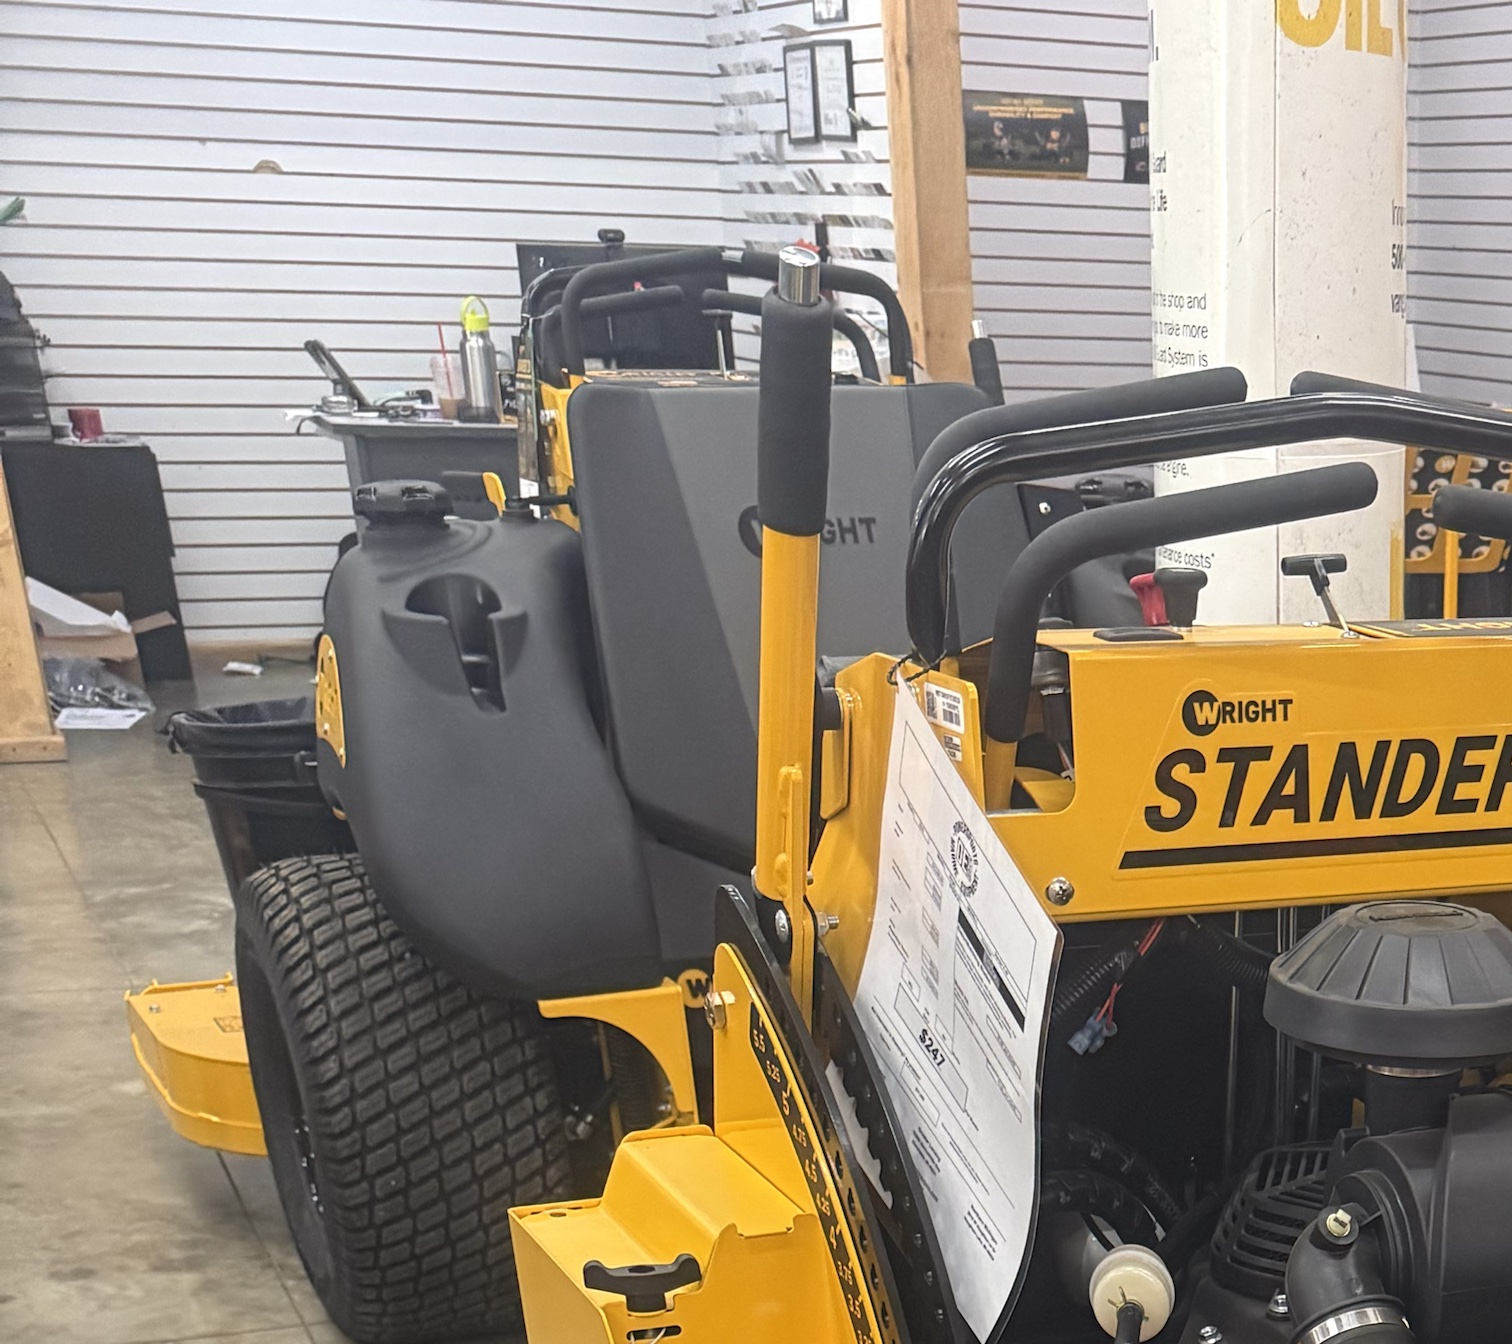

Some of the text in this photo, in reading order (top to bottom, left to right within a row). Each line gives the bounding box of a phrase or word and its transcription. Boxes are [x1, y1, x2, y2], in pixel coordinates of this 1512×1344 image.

[1187, 293, 1206, 310] and
[1183, 324, 1208, 339] more
[1198, 350, 1209, 367] is
[1182, 689, 1293, 736] WRIGHT
[753, 1029, 766, 1053] 5.5
[918, 1028, 946, 1067] $247
[765, 1060, 780, 1083] 5.25
[781, 1090, 790, 1116] 5
[792, 1124, 807, 1148] 4.75
[804, 1159, 817, 1183] 4.5
[816, 1193, 831, 1217] 4.25
[829, 1226, 837, 1250] 4
[838, 1260, 852, 1286] 3.75
[848, 1293, 862, 1319] 3.5
